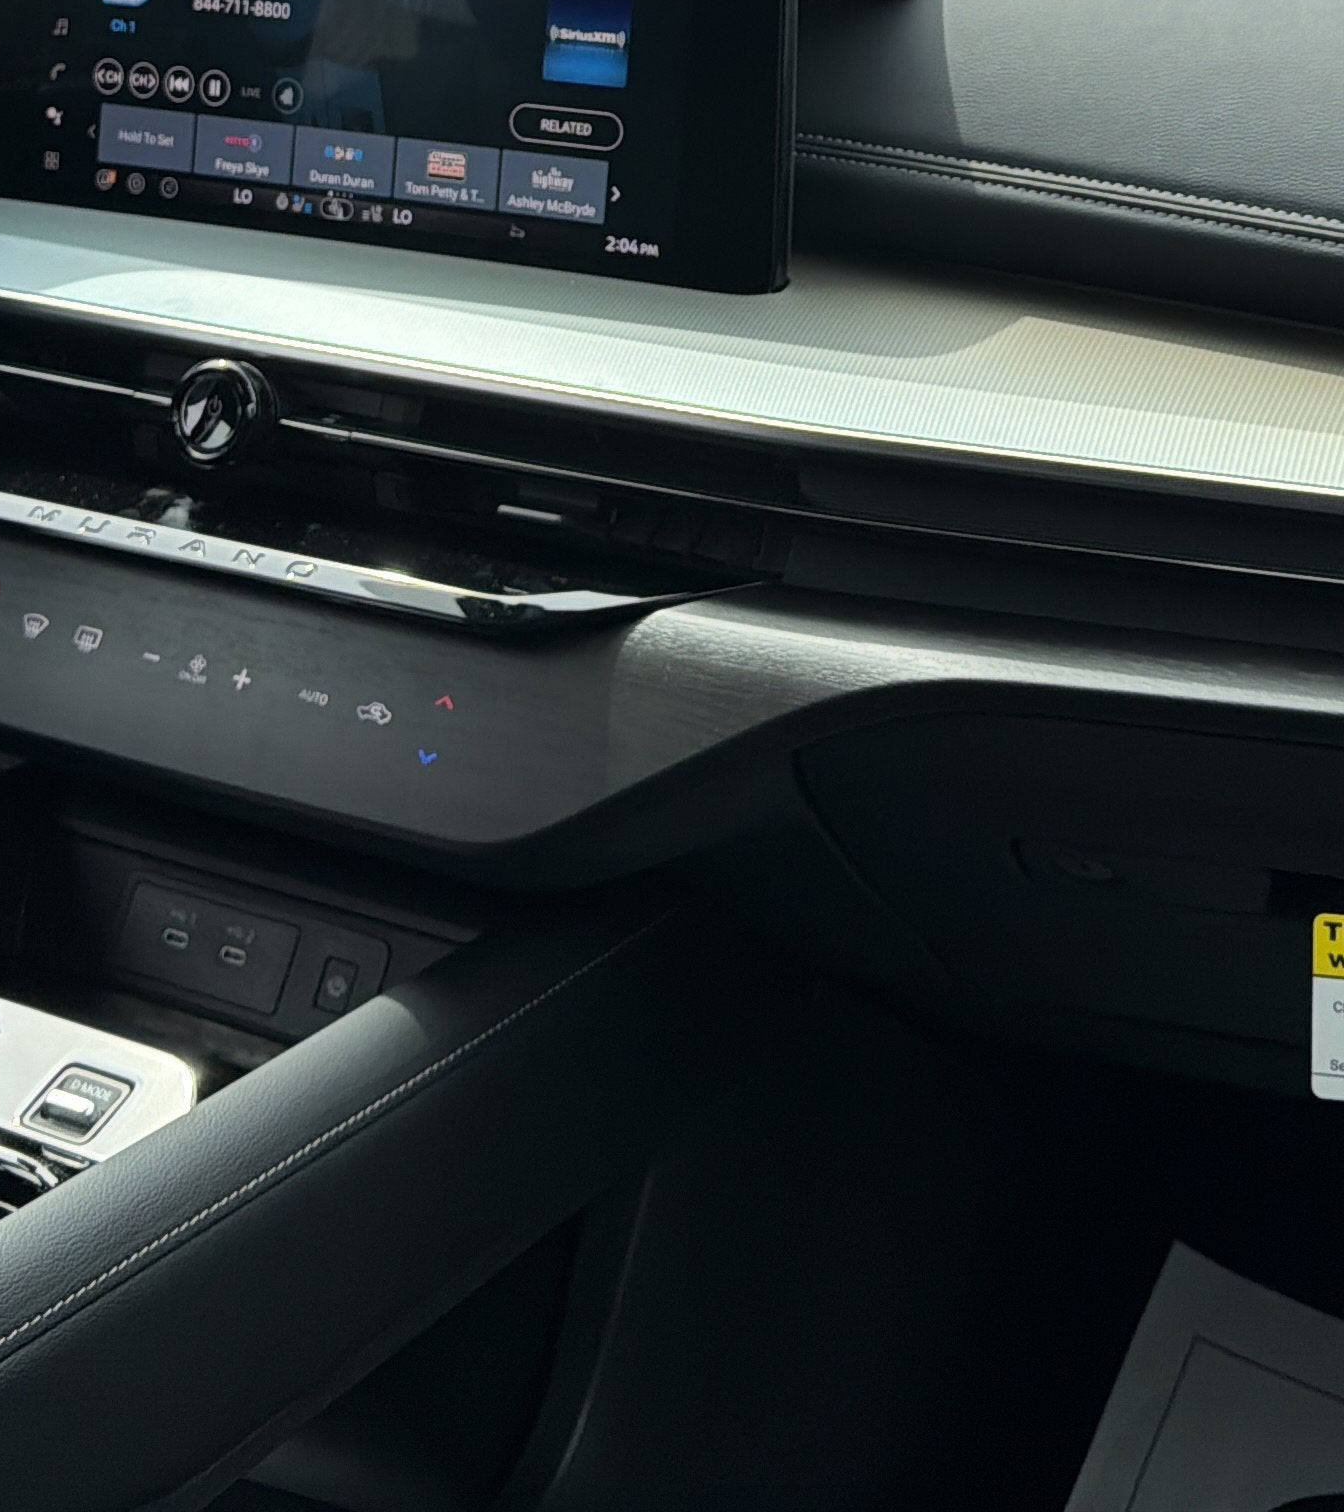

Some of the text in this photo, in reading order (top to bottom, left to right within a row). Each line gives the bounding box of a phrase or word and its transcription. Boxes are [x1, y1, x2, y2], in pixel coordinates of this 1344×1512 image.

[110, 18, 128, 33] Ch
[540, 118, 592, 136] RELATED
[117, 129, 174, 148] Hold To Set
[215, 158, 269, 177] Freya Skye
[309, 168, 375, 189] Duran Duran
[532, 170, 574, 193] highway
[232, 188, 253, 206] LO
[405, 180, 430, 196] Tom
[430, 183, 458, 202] Petty
[460, 188, 469, 201] &
[507, 194, 596, 219] Ashley McBryde
[392, 208, 413, 226] LO
[604, 235, 659, 258] 2:04 PM
[28, 505, 318, 580] MURANO
[298, 689, 329, 707] AUTO
[80, 1083, 114, 1102] MODE
